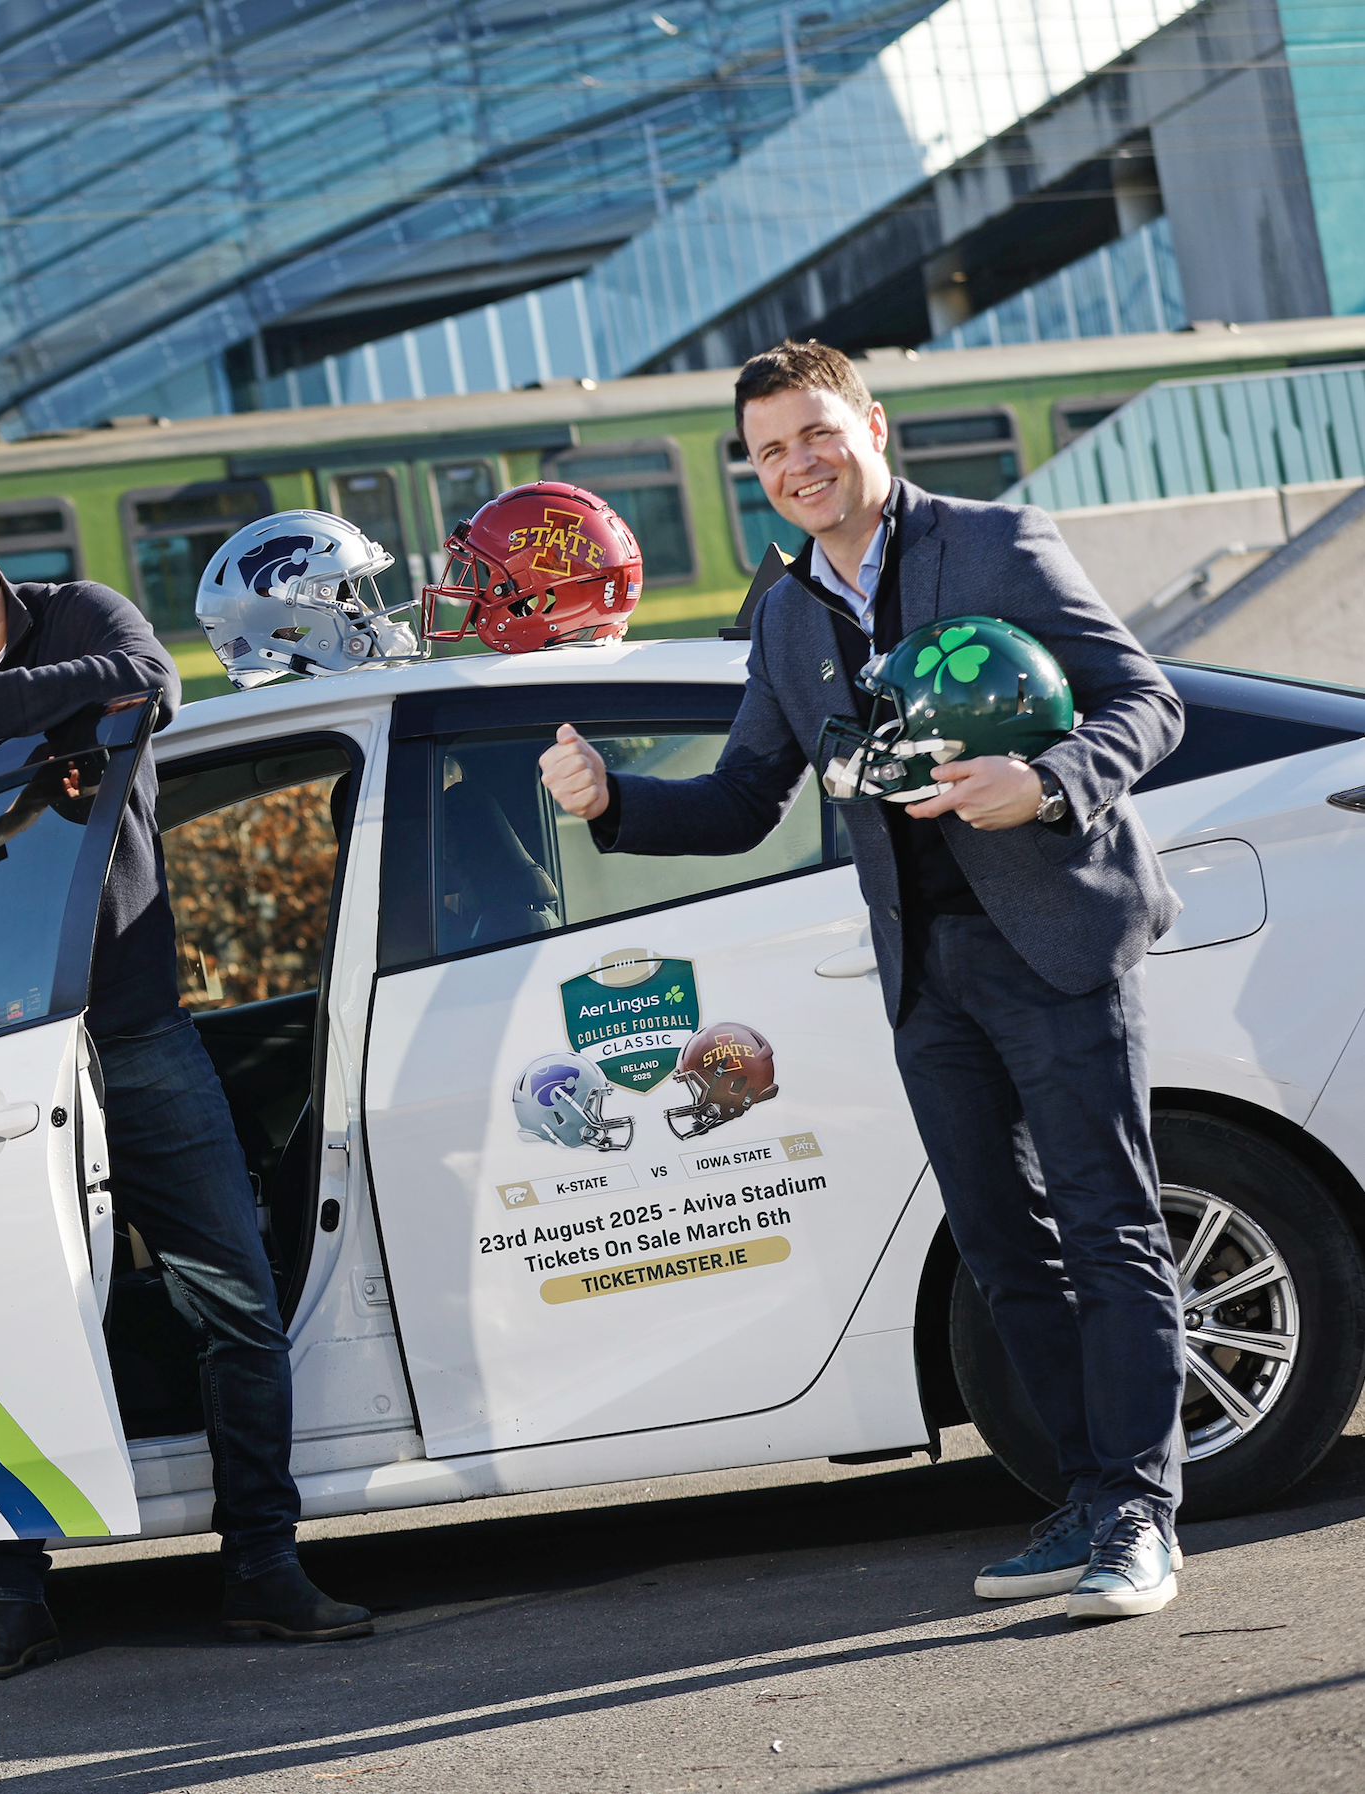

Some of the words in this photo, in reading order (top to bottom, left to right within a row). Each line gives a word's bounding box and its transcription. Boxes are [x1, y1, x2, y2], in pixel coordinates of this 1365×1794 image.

[508, 526, 605, 570] STATE
[579, 1003, 606, 1019] Aer
[608, 995, 660, 1013] Lingus
[577, 1022, 627, 1045] COLLEGE
[632, 1015, 692, 1031] FOOTBALL
[602, 1034, 672, 1055] CLASSIC
[703, 1044, 755, 1068] STATE
[620, 1059, 659, 1074] IRELAND
[632, 1072, 652, 1081] 2025
[696, 1155, 730, 1170] IOWA
[733, 1148, 772, 1164] STATE
[788, 1142, 815, 1154] STATE
[650, 1165, 668, 1178] VS
[556, 1176, 609, 1194] K-STATE
[479, 1229, 527, 1254] 23rd
[534, 1215, 606, 1243] August
[609, 1203, 663, 1229] 2025
[683, 1193, 737, 1215] Aviva
[741, 1174, 827, 1203] Stadium
[524, 1246, 600, 1273] Tickets
[605, 1238, 633, 1258] On
[637, 1229, 681, 1251] Sale
[686, 1214, 751, 1242] March
[756, 1207, 791, 1229] 6th
[581, 1248, 748, 1293] TICKETMASTER.IE
